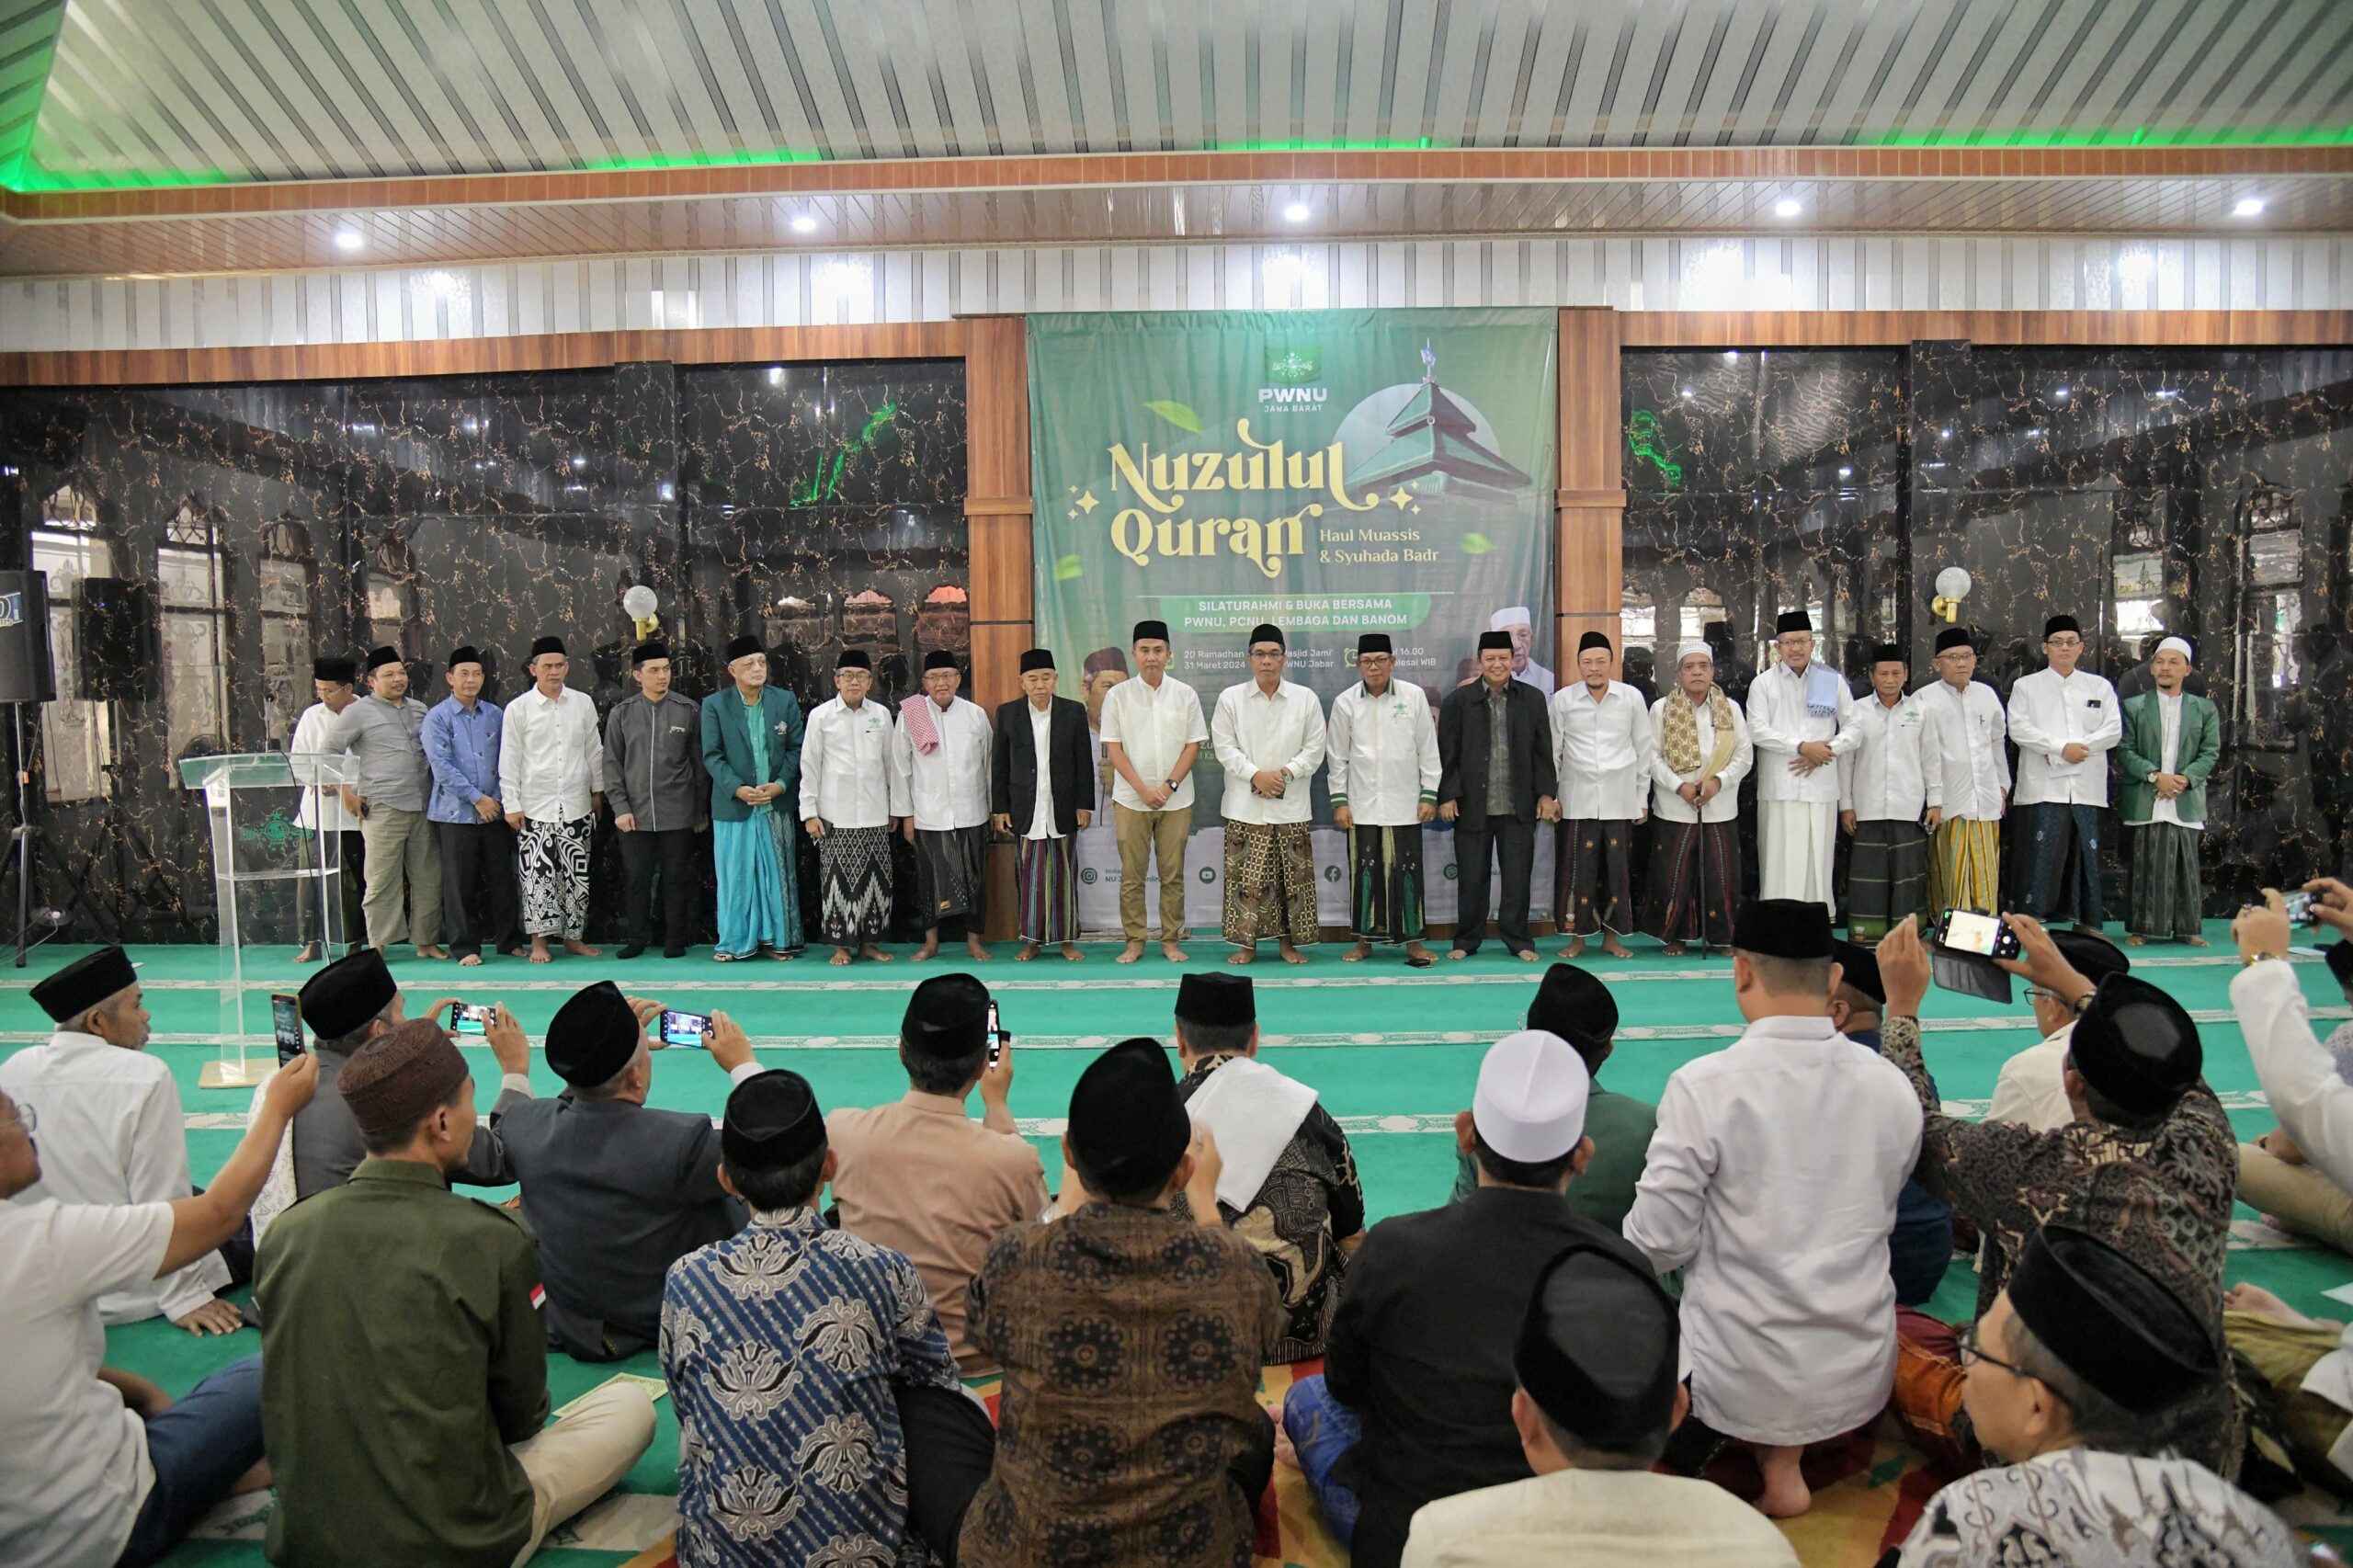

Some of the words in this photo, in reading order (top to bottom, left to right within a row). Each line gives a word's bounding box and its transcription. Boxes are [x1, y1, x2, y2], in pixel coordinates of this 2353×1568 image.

[1258, 388, 1327, 403] PWNU
[1292, 404, 1322, 413] BARAT
[1107, 418, 1379, 513] Nuzulul
[1110, 504, 1324, 578] Quran
[1319, 528, 1354, 542] Haul
[1358, 528, 1420, 542] Muassis
[1319, 550, 1331, 563] &
[1335, 549, 1398, 566] Syuhada
[1404, 548, 1439, 562] Badr
[1199, 600, 1282, 611] SILATURAHMI
[1285, 600, 1293, 610] &
[1296, 599, 1329, 610] BUKA
[1334, 598, 1392, 609] BERSAMA
[1184, 617, 1225, 628] PWNU,
[1272, 615, 1329, 626] LEMBAGA
[1334, 615, 1358, 625] DAN
[1362, 614, 1407, 625] BANOM
[1184, 650, 1196, 659] 20
[1198, 650, 1245, 659] Ramadhan
[1286, 648, 1308, 659] asjid
[1399, 647, 1424, 656] 16.00
[1184, 661, 1194, 670] 31
[1196, 661, 1221, 670] Maret
[1222, 660, 1245, 669] 2024
[1308, 660, 1334, 668] Jabar
[1394, 657, 1418, 666] elesai
[1420, 657, 1437, 666] WIB
